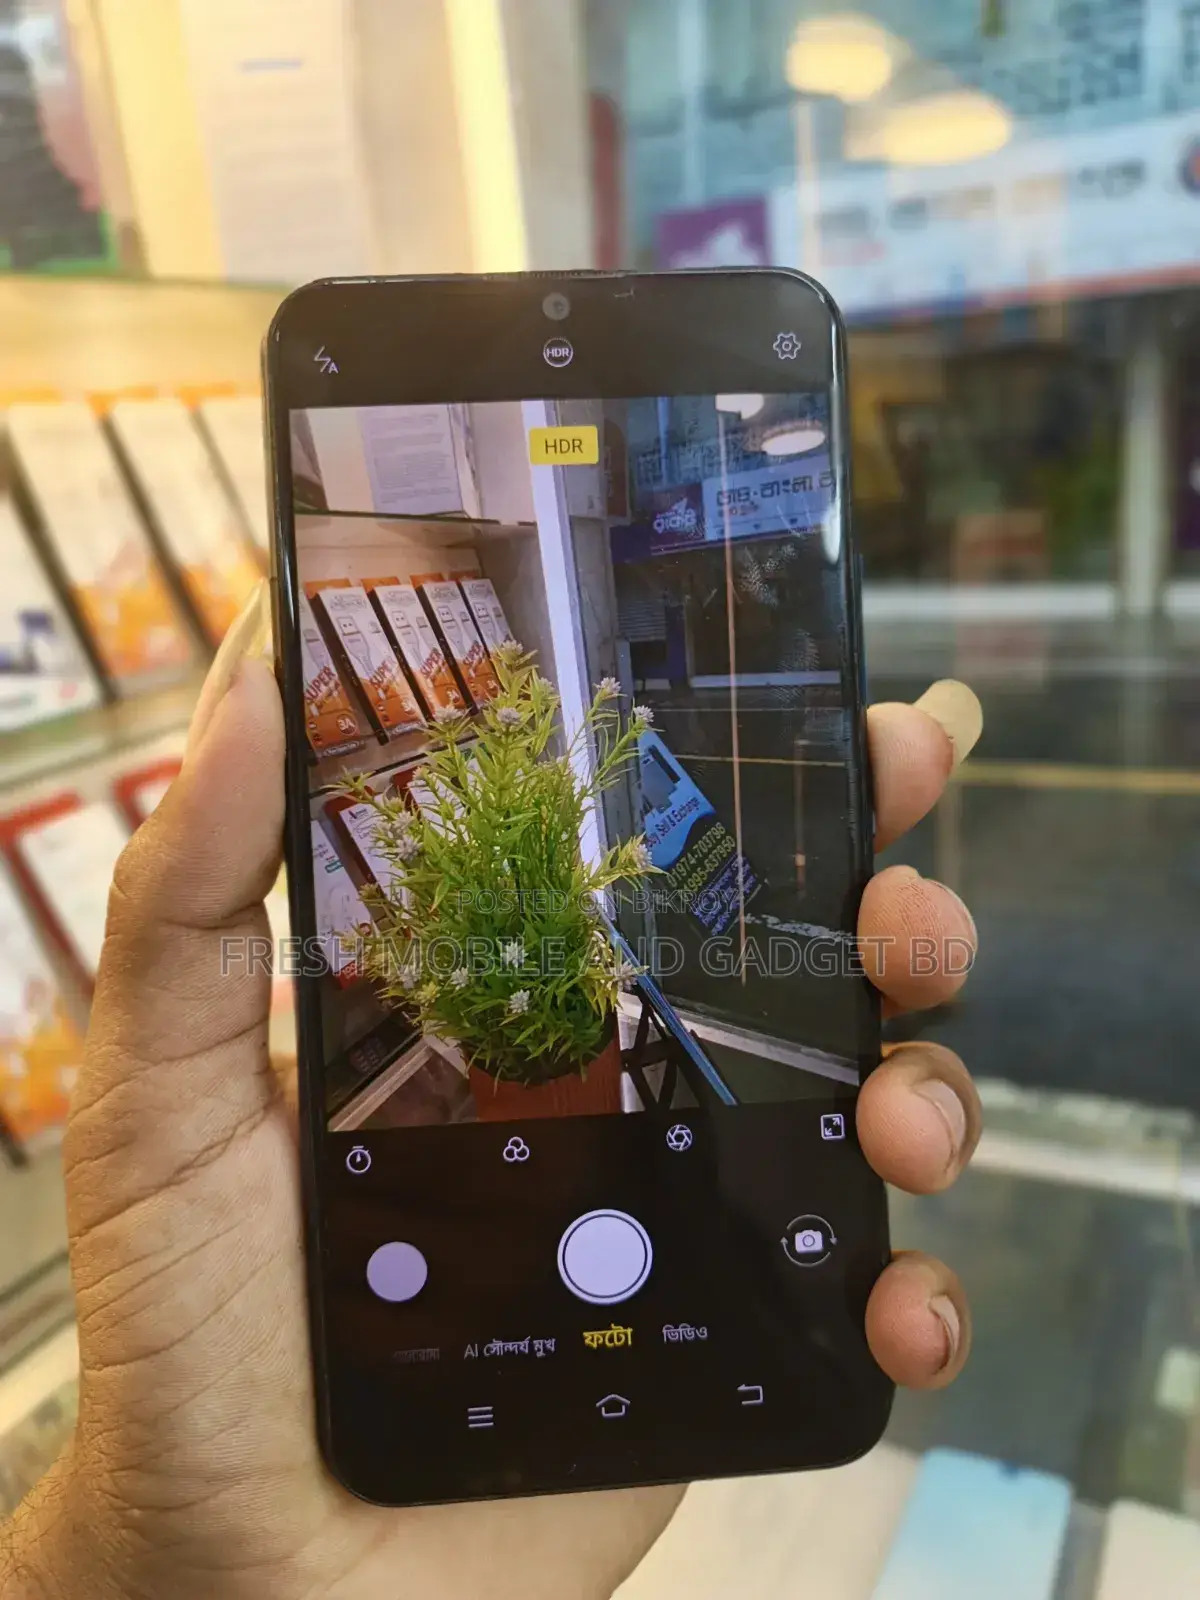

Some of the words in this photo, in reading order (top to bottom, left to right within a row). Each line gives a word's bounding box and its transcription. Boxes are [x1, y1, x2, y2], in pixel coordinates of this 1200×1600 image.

[546, 346, 569, 359] HDR
[544, 438, 584, 455] HDR
[665, 821, 727, 888] 01974-703798
[682, 835, 737, 894] 1995-637950
[583, 1322, 633, 1350] ফটো
[662, 1322, 708, 1344] ভিডিও
[464, 1343, 479, 1360] AI
[484, 1335, 530, 1358] সৌন্দর্য
[534, 1337, 556, 1358] মুখ
